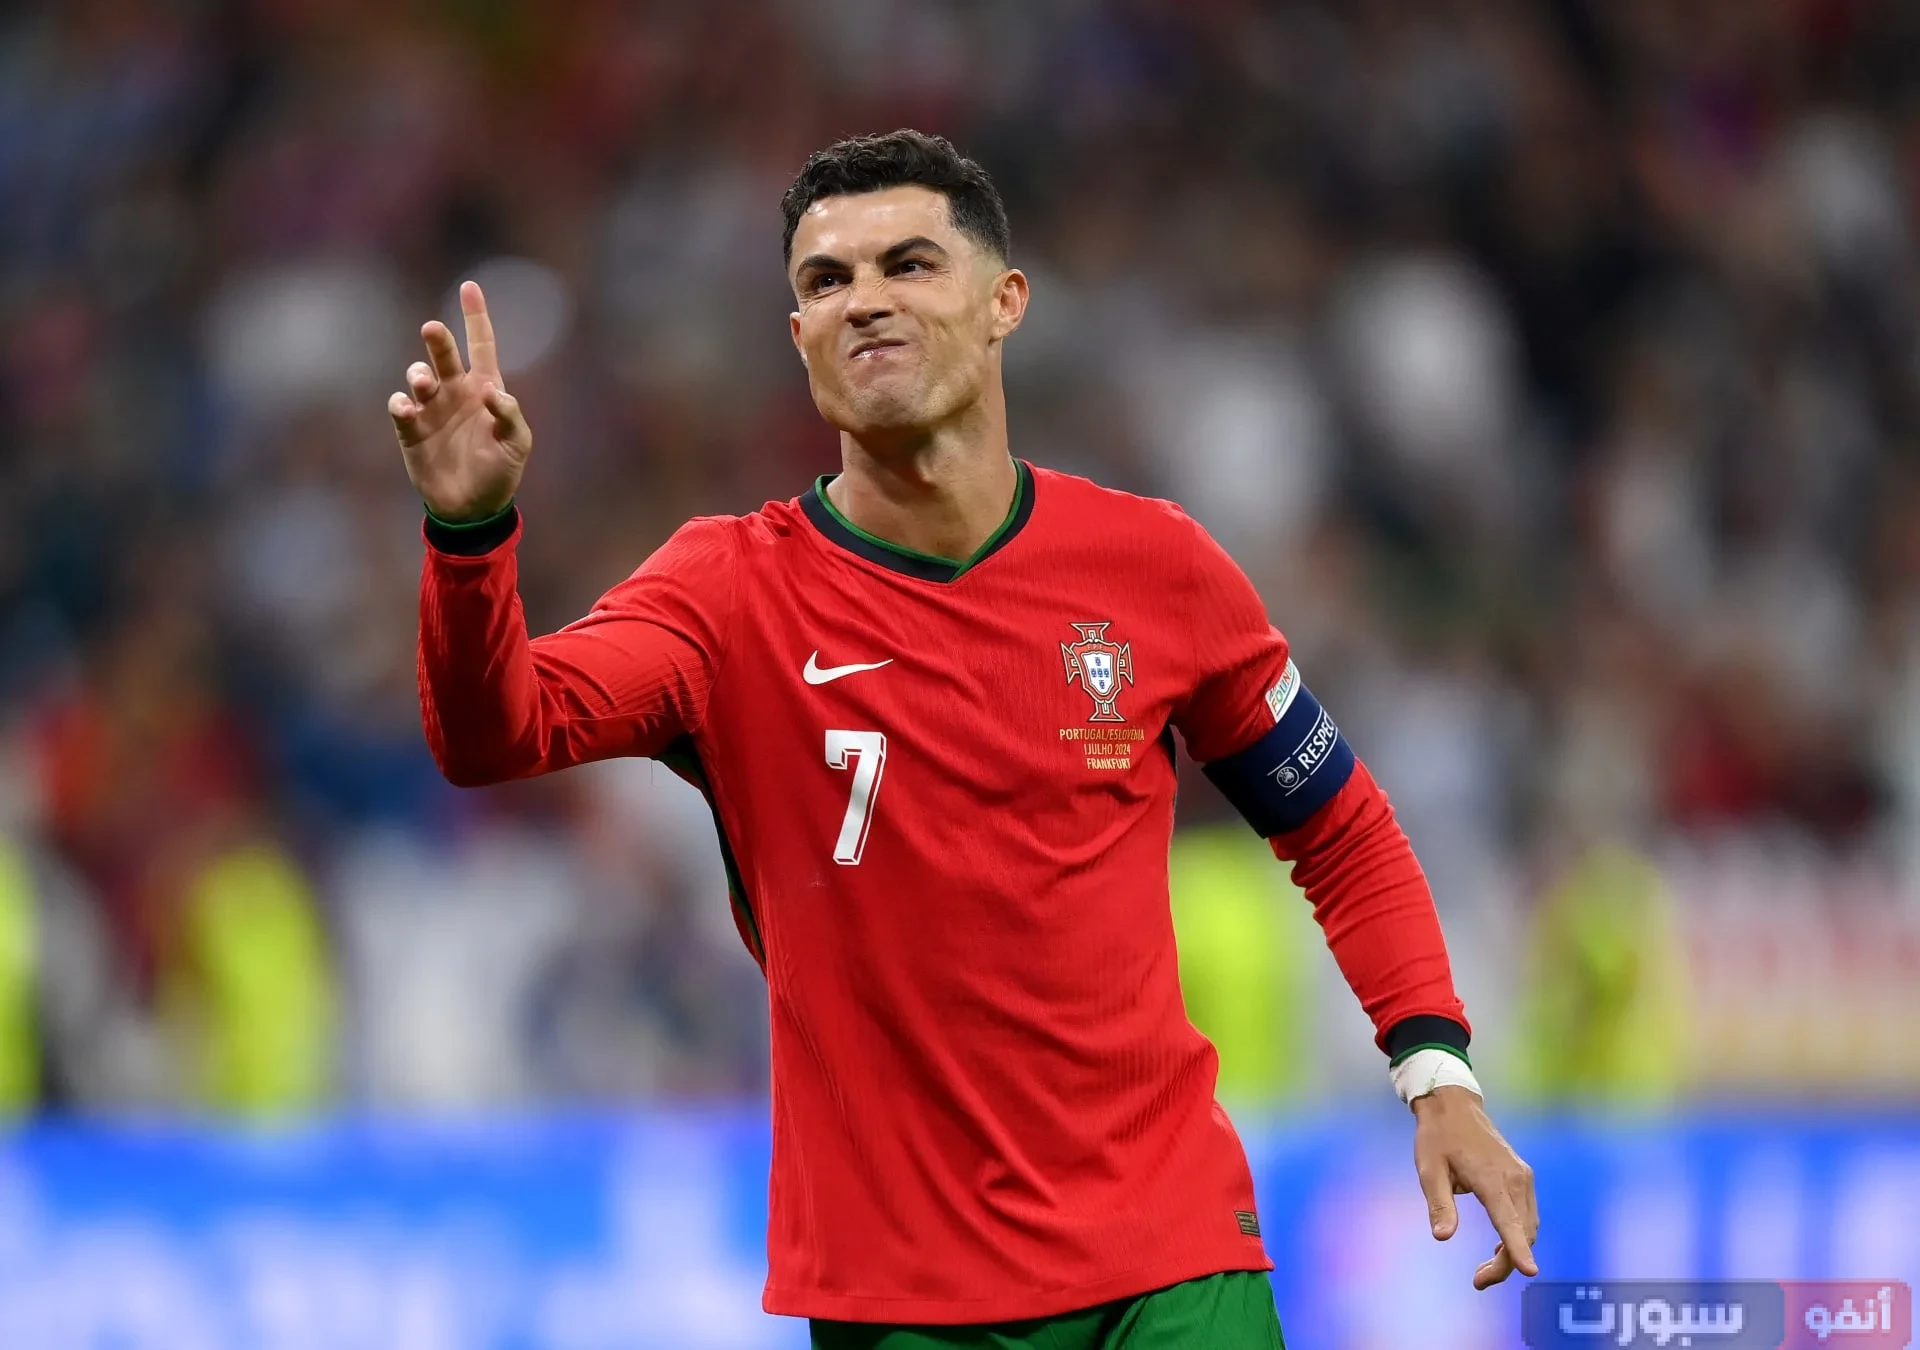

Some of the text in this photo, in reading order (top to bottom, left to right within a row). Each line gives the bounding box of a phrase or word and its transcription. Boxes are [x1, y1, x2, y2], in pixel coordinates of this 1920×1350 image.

[1114, 743, 1131, 755] 2024
[1298, 710, 1334, 770] RESPEC
[1086, 757, 1131, 769] FRANKFURT
[825, 730, 886, 865] 7
